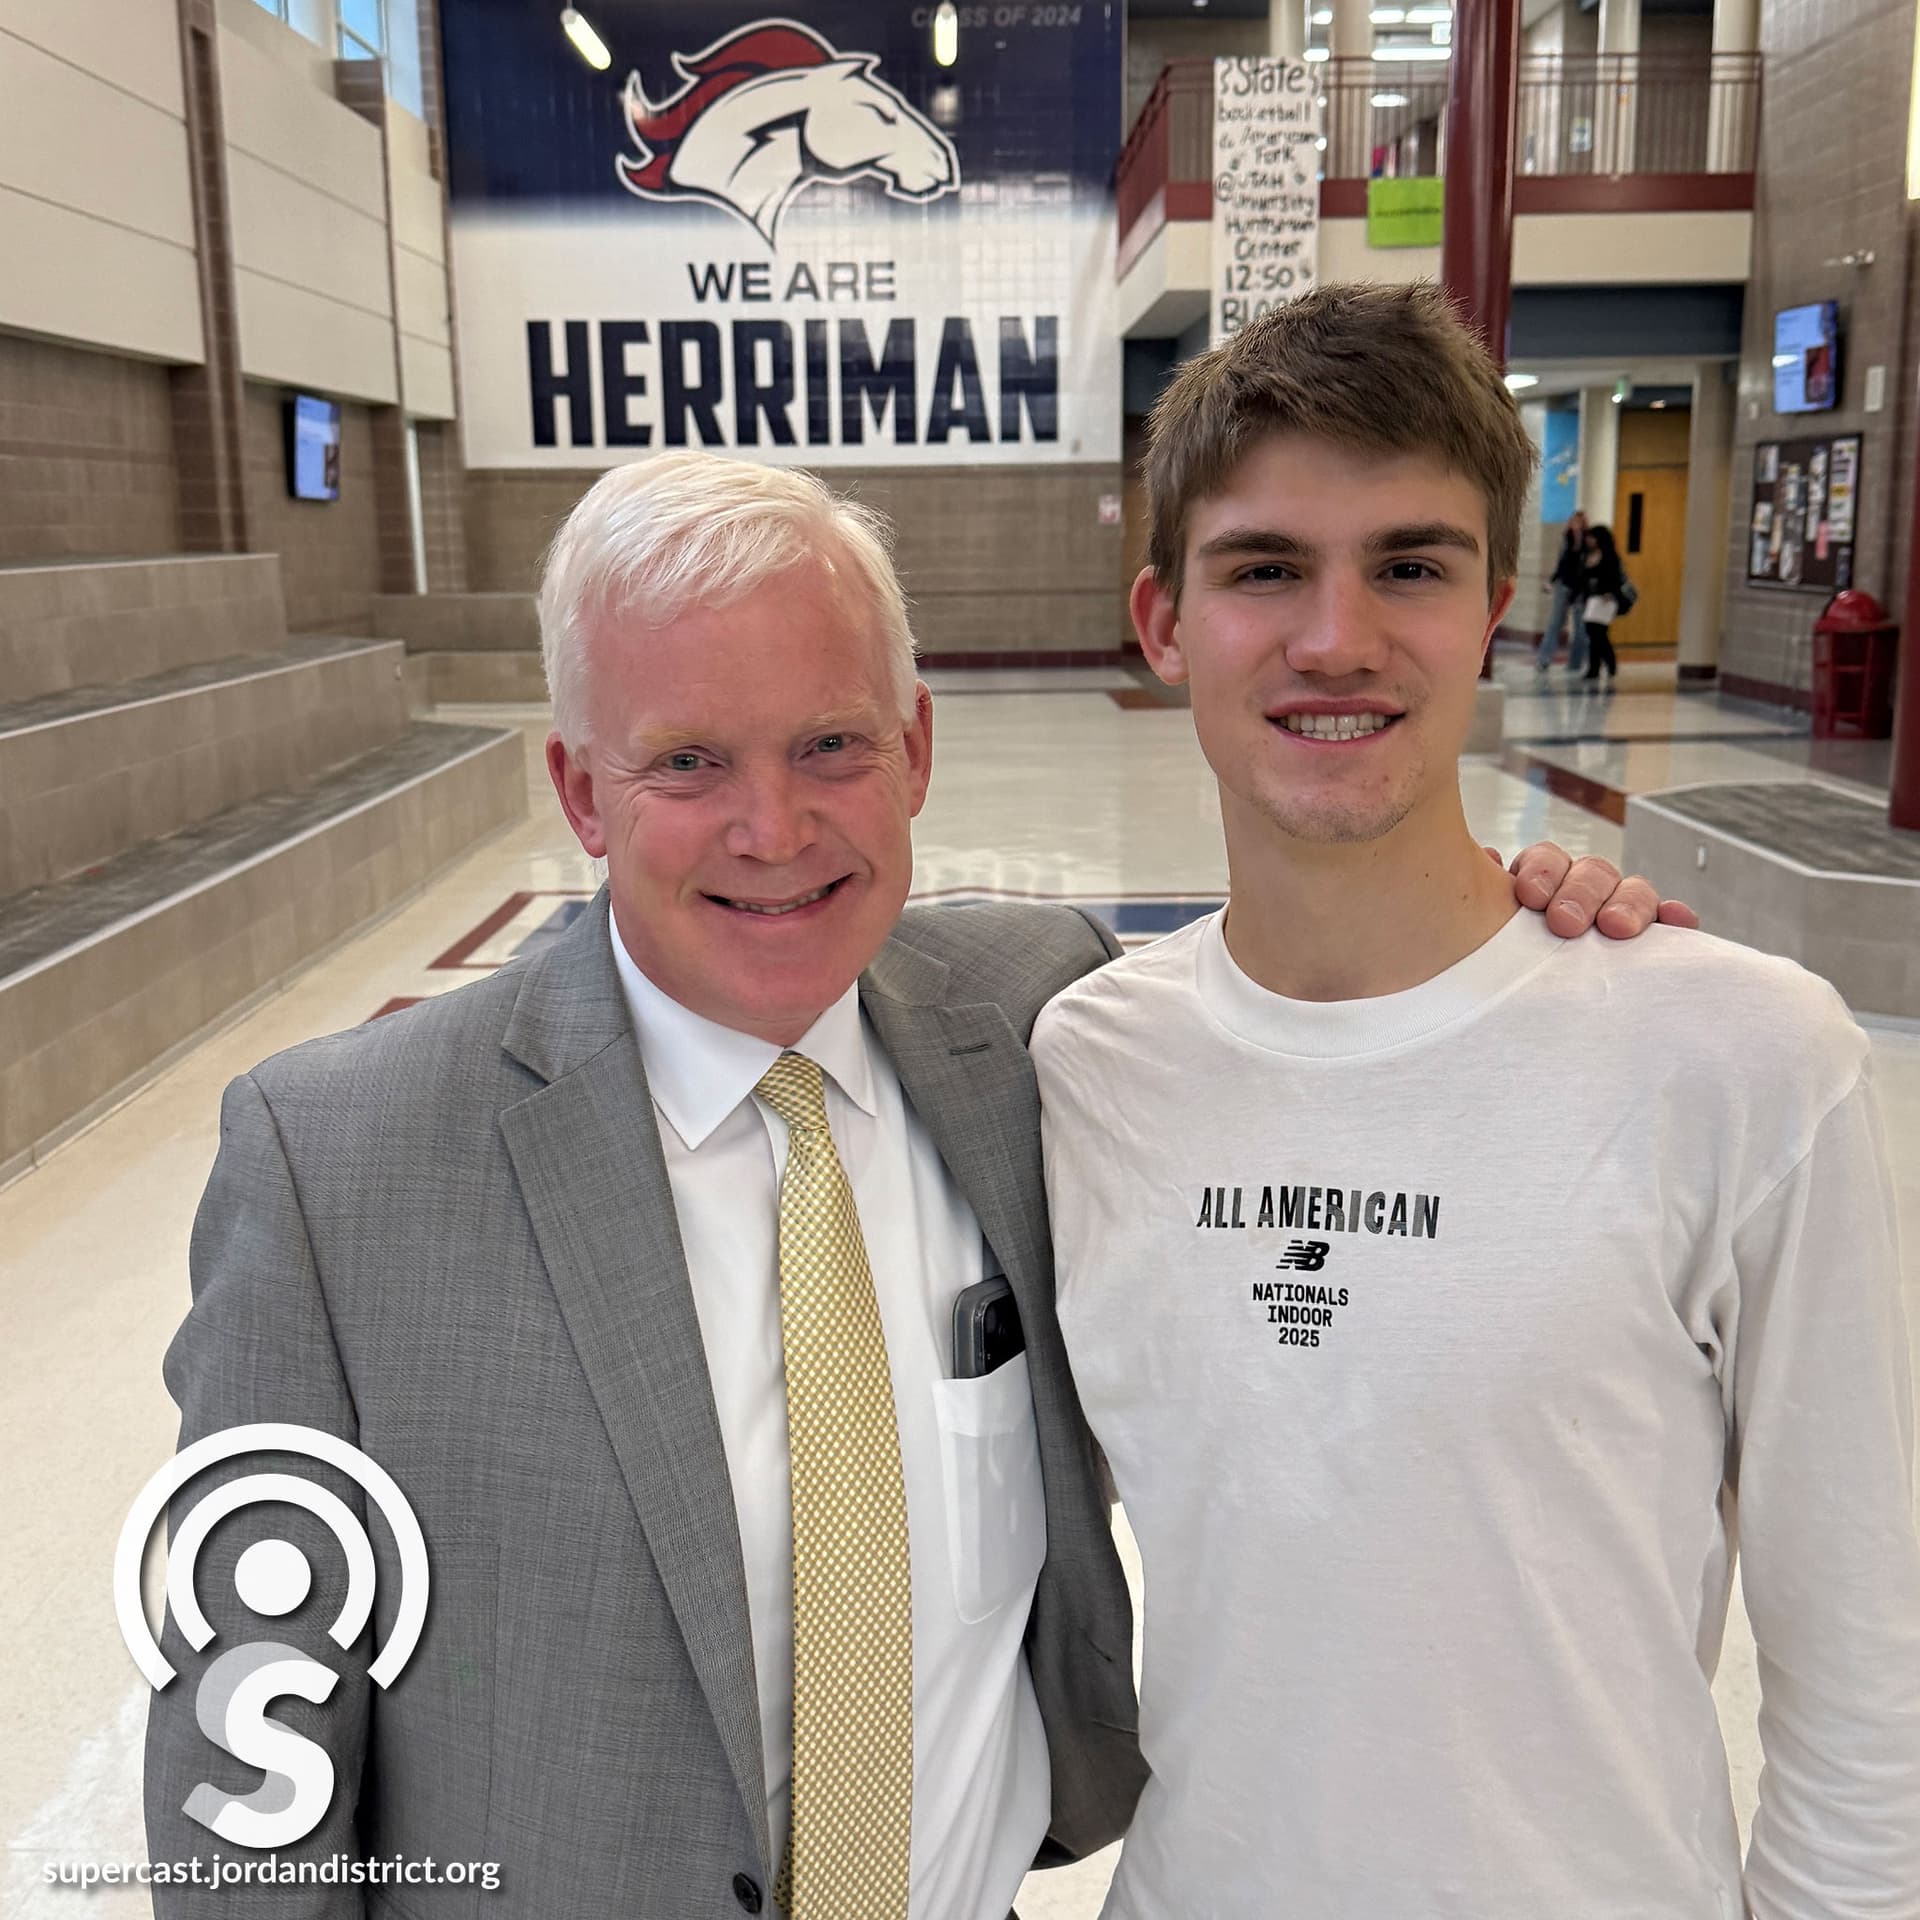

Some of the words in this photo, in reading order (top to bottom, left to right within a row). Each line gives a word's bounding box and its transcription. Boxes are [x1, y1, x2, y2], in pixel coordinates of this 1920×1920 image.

[993, 6, 1027, 27] OF
[1031, 5, 1082, 26] 2024
[1233, 58, 1306, 96] State
[688, 262, 771, 302] WE
[785, 261, 897, 301] ARE
[1226, 264, 1295, 292] 12:50
[526, 316, 1058, 447] HERRIMAN
[1197, 1187, 1246, 1229] ALL
[1257, 1186, 1441, 1239] AMERICAN
[1252, 1283, 1349, 1306] NATIONALS
[1267, 1305, 1333, 1327] INDOOR
[1278, 1327, 1320, 1347] 2025
